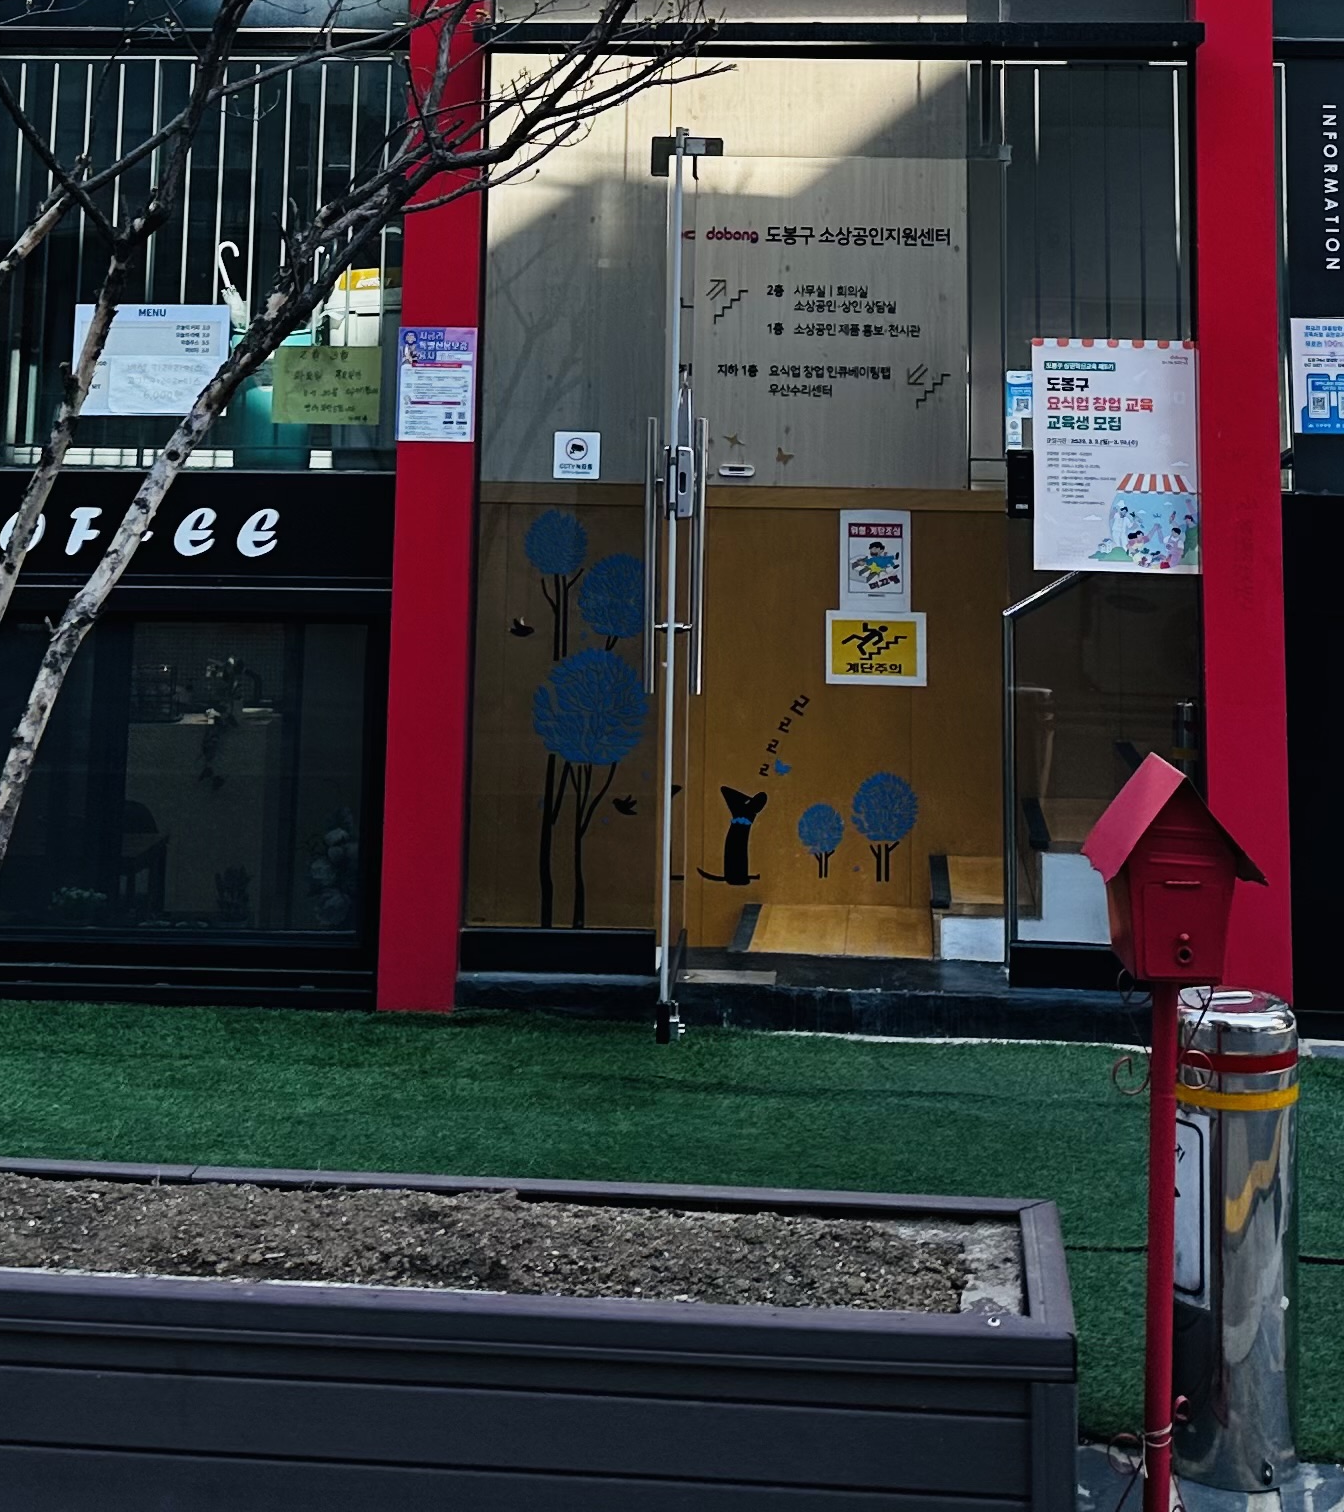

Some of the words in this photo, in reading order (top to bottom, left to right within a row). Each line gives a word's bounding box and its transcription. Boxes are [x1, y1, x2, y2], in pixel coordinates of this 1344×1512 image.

[1322, 104, 1341, 270] INFORMATION
[706, 227, 759, 243] dobong
[765, 226, 816, 246] 도봉구
[818, 226, 951, 246] 소상공인지원센터
[767, 285, 784, 297] 2층
[794, 285, 826, 298] 사무실
[836, 285, 868, 298] 회의실
[138, 308, 167, 318] MENU
[864, 300, 896, 314] 상담실
[767, 323, 784, 335] 1층
[794, 323, 837, 336] 소상공인
[838, 324, 860, 336] 제품
[717, 364, 739, 377] 지하
[741, 365, 759, 377] 1층
[769, 365, 801, 378] 요식업
[803, 365, 825, 378] 창업
[769, 384, 833, 397] 우산수리센터
[1047, 377, 1089, 391] 도봉구
[1047, 396, 1089, 411] 요식업
[1093, 397, 1121, 411] 창업
[1125, 398, 1154, 412] 교육
[1047, 415, 1089, 430] 교육생
[1093, 416, 1121, 431] 모집
[846, 662, 902, 674] 계단주의
